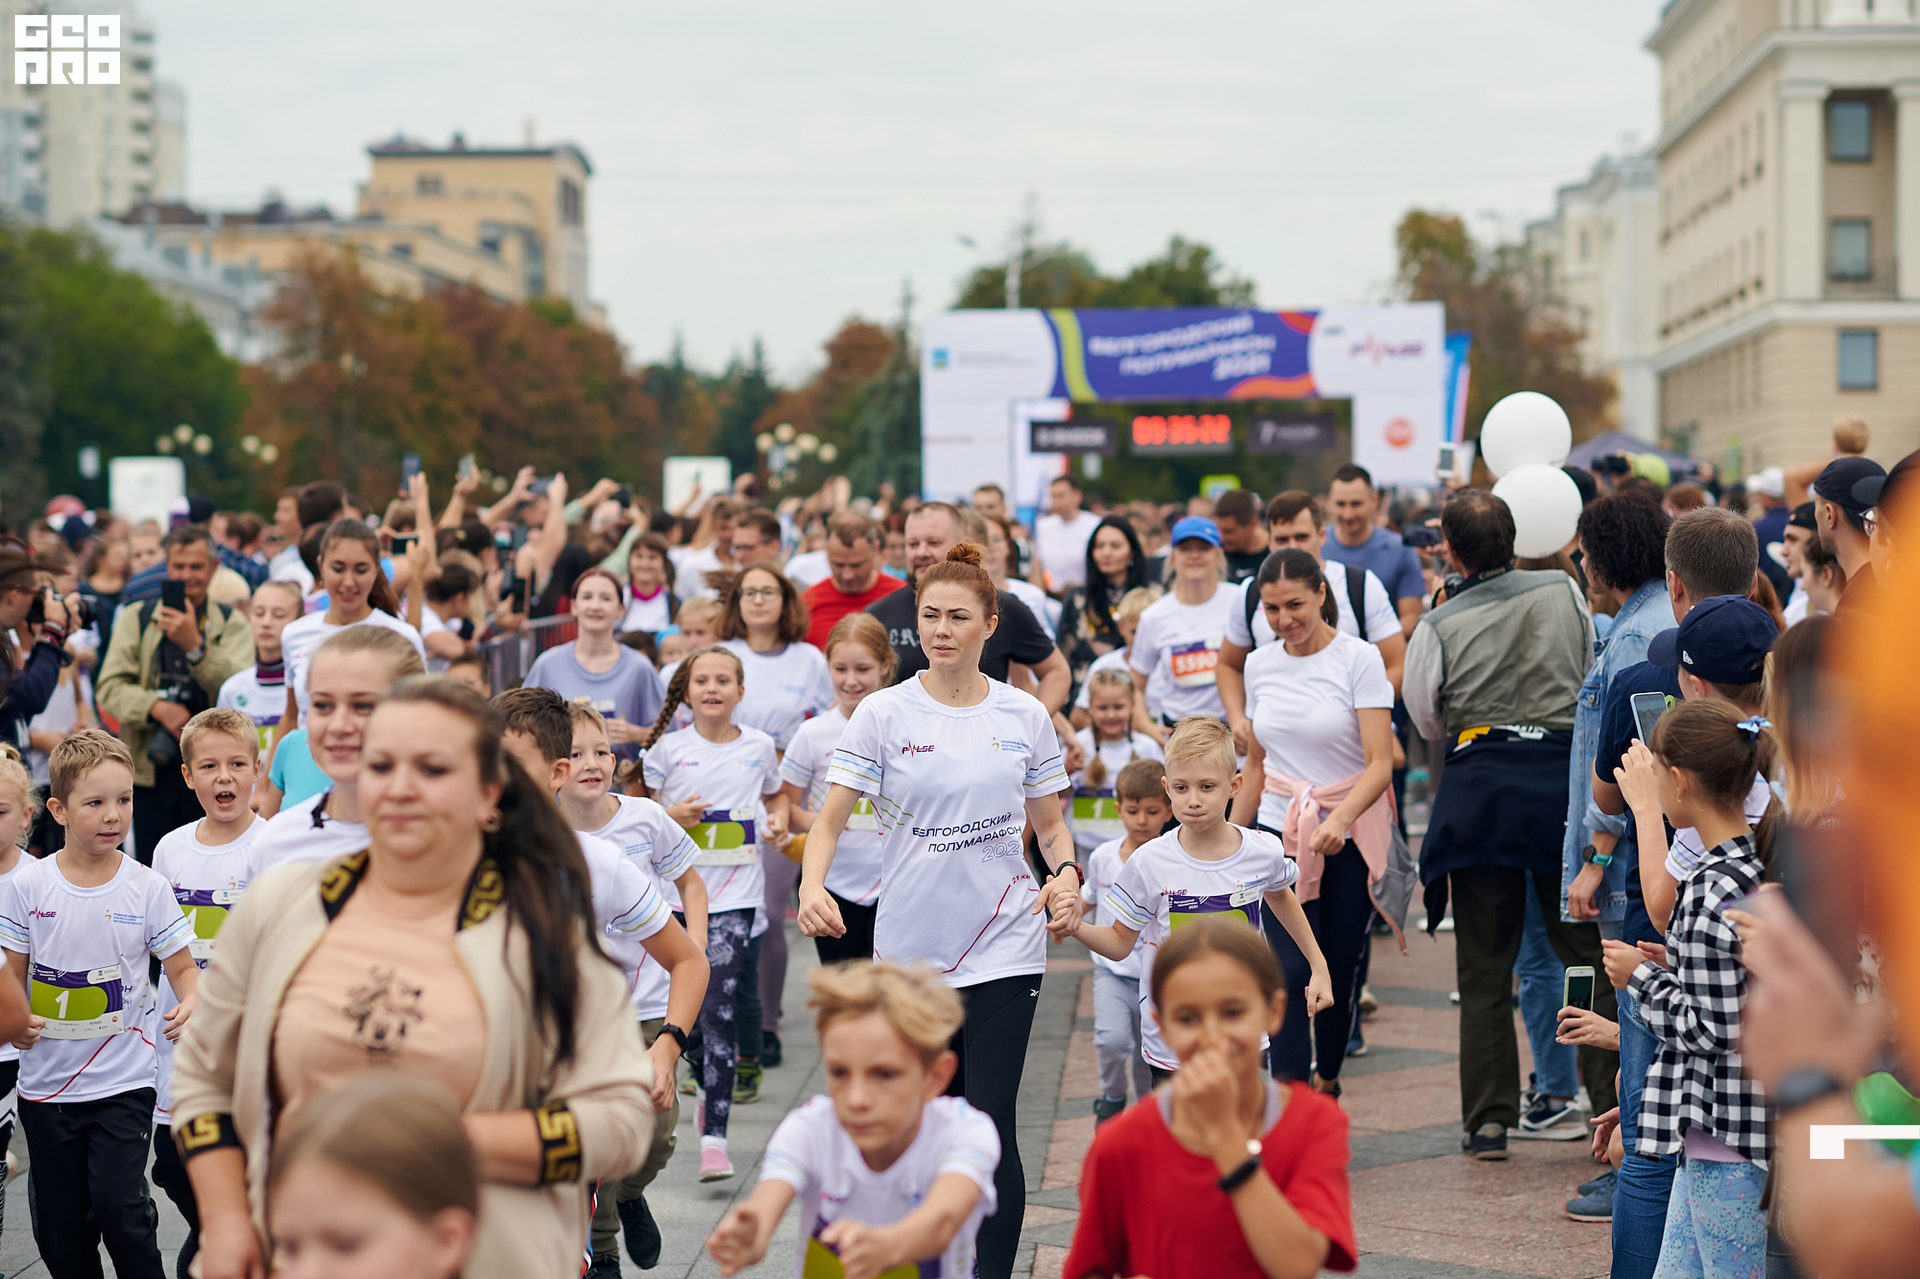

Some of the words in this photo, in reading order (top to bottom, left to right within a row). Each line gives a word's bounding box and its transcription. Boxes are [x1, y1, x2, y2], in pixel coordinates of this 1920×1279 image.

[1088, 313, 1254, 357] БЕЛГОРОДСКИЙ
[1119, 334, 1276, 376] ПОЛУМАРАФОН
[1212, 352, 1271, 381] 2021
[1175, 650, 1218, 674] 5590
[1092, 798, 1103, 819] 1
[705, 824, 717, 849] 1
[912, 812, 1012, 838] БЕЛГОРОДСКИЙ
[927, 826, 1022, 853] ПОЛУМАРАФОН
[55, 990, 70, 1019] 1
